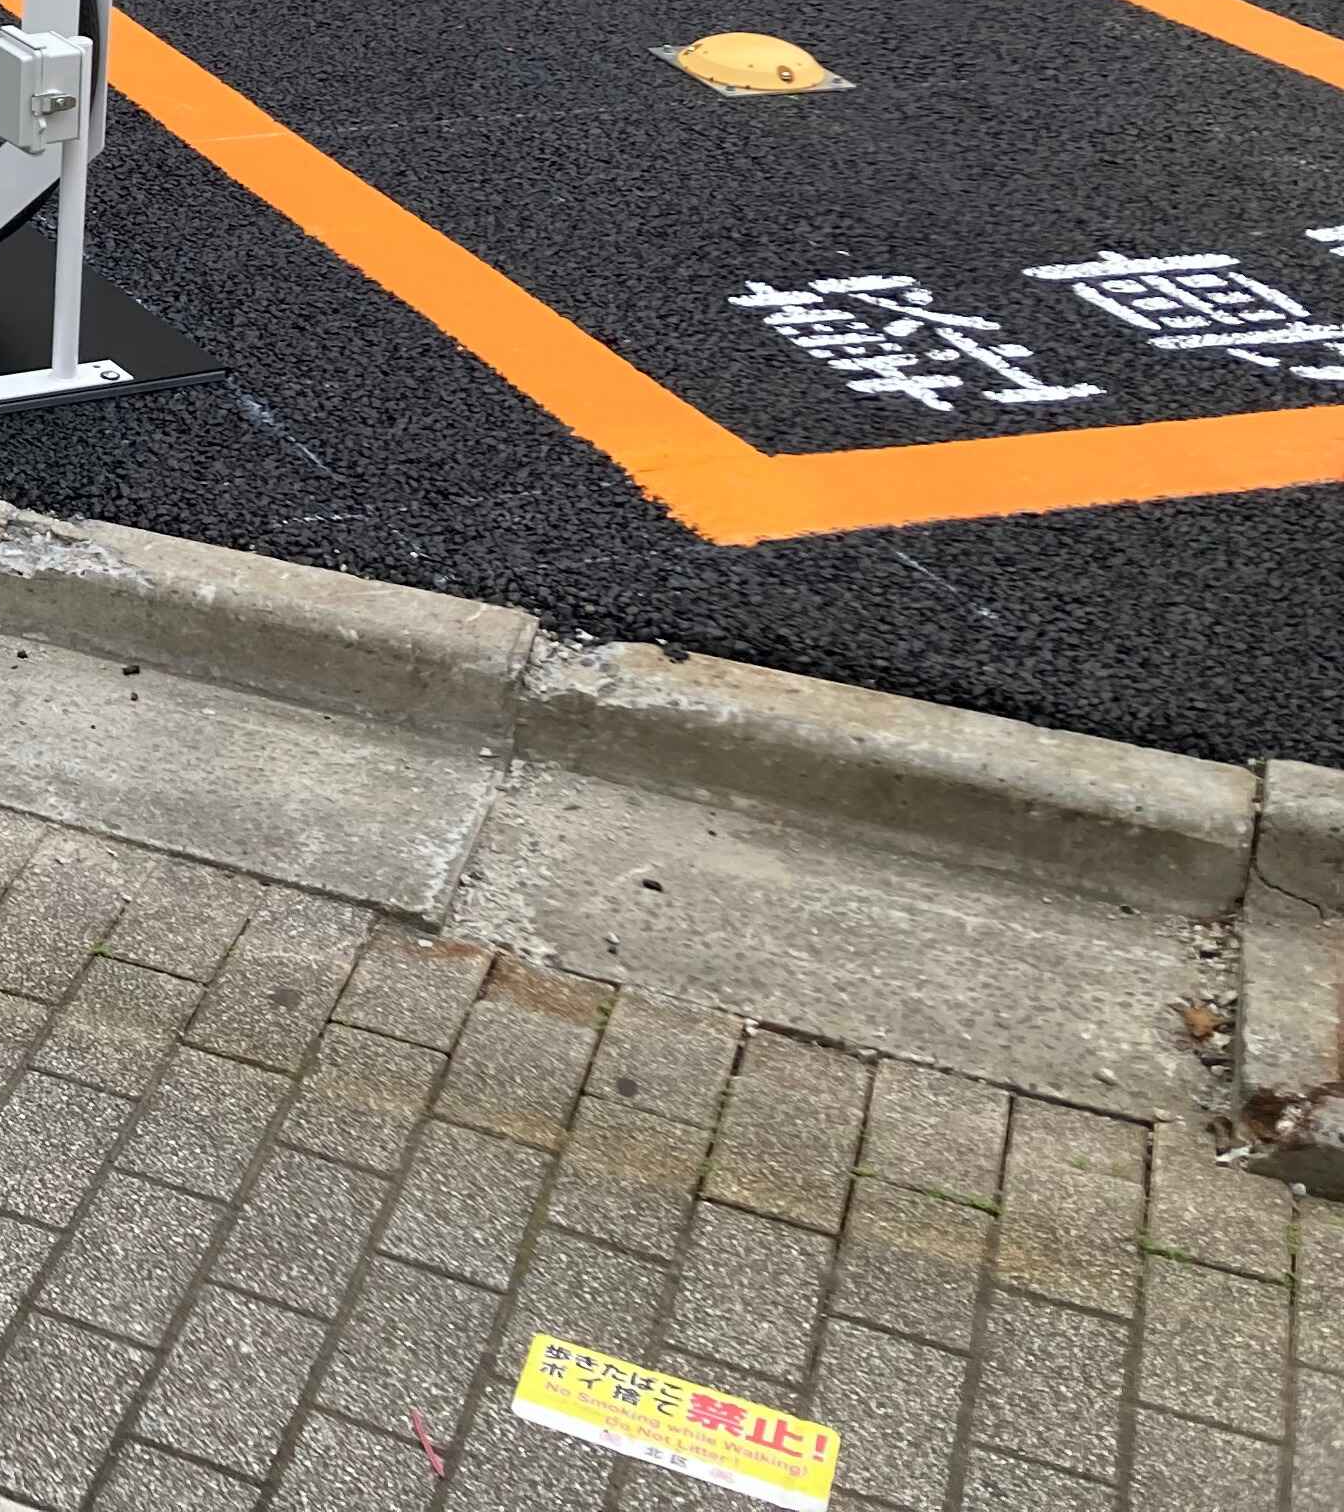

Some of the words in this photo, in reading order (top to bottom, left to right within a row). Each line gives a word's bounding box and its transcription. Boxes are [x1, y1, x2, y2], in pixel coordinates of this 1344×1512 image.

[544, 1344, 683, 1402] 歩きたばこ
[544, 1381, 571, 1396] No
[577, 1391, 661, 1429] Smoking
[667, 1423, 717, 1446] while
[686, 1392, 828, 1462] 禁止!
